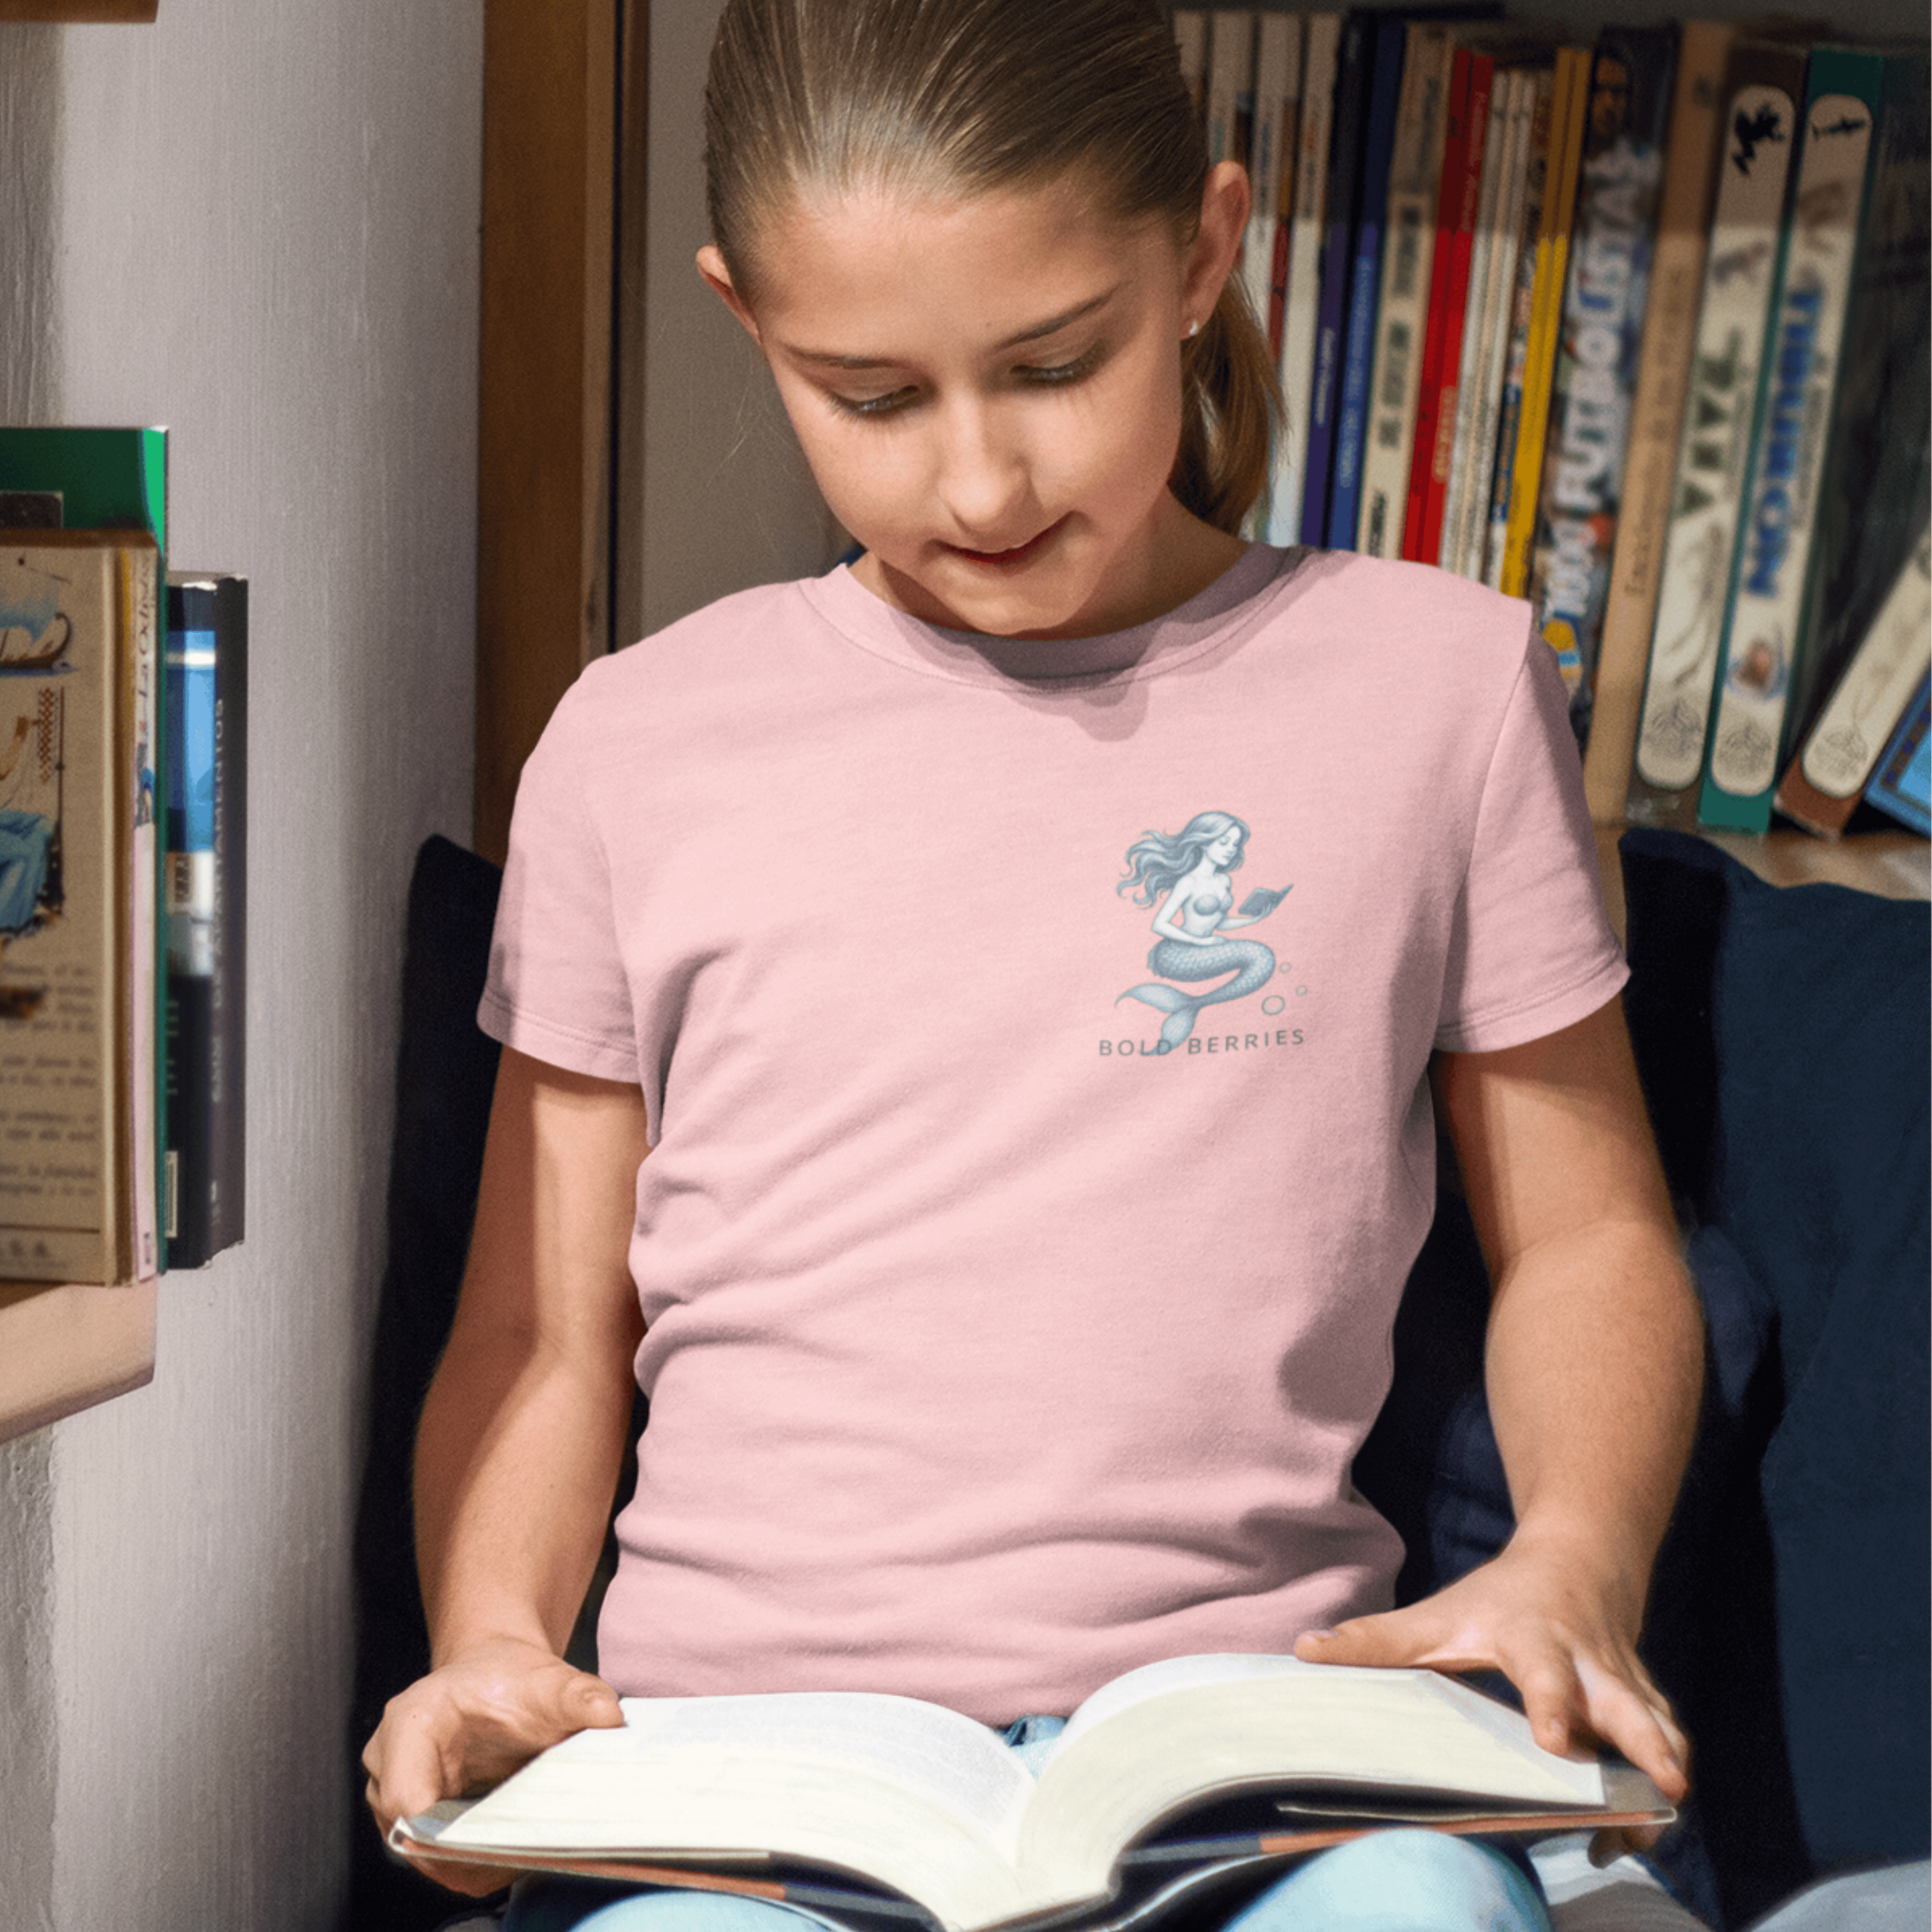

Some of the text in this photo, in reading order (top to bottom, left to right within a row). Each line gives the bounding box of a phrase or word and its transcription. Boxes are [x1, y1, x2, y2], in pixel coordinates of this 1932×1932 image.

[1552, 143, 1661, 509] FUTBOLISTAS
[1099, 1028, 1305, 1056] BOLD BERRIES
